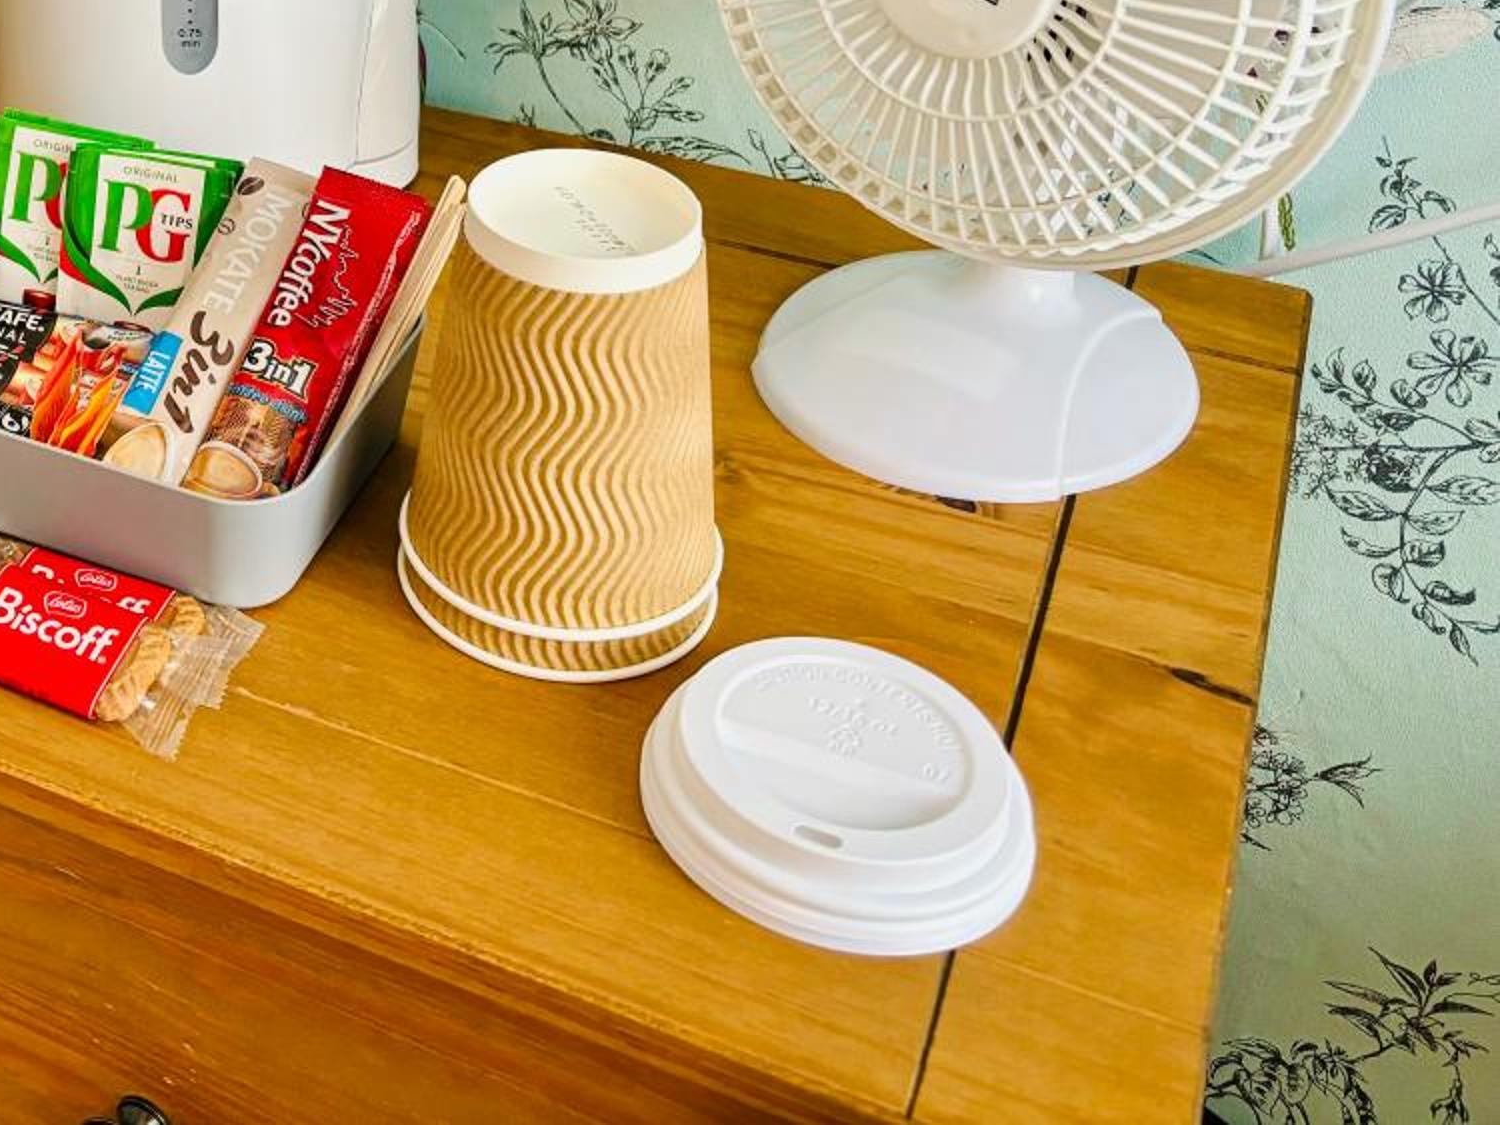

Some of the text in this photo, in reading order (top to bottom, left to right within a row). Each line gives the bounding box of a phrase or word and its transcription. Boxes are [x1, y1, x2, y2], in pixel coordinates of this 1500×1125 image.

[177, 28, 203, 38] 0.75
[181, 39, 202, 48] min
[122, 165, 178, 184] ORIGINAL
[98, 178, 192, 264] PG
[160, 212, 194, 230] TIPS
[204, 188, 293, 314] MOKATE
[267, 199, 351, 327] NYcoffee
[135, 350, 171, 394] LATTE
[163, 310, 235, 433] 3in1
[242, 339, 313, 397] 3in1
